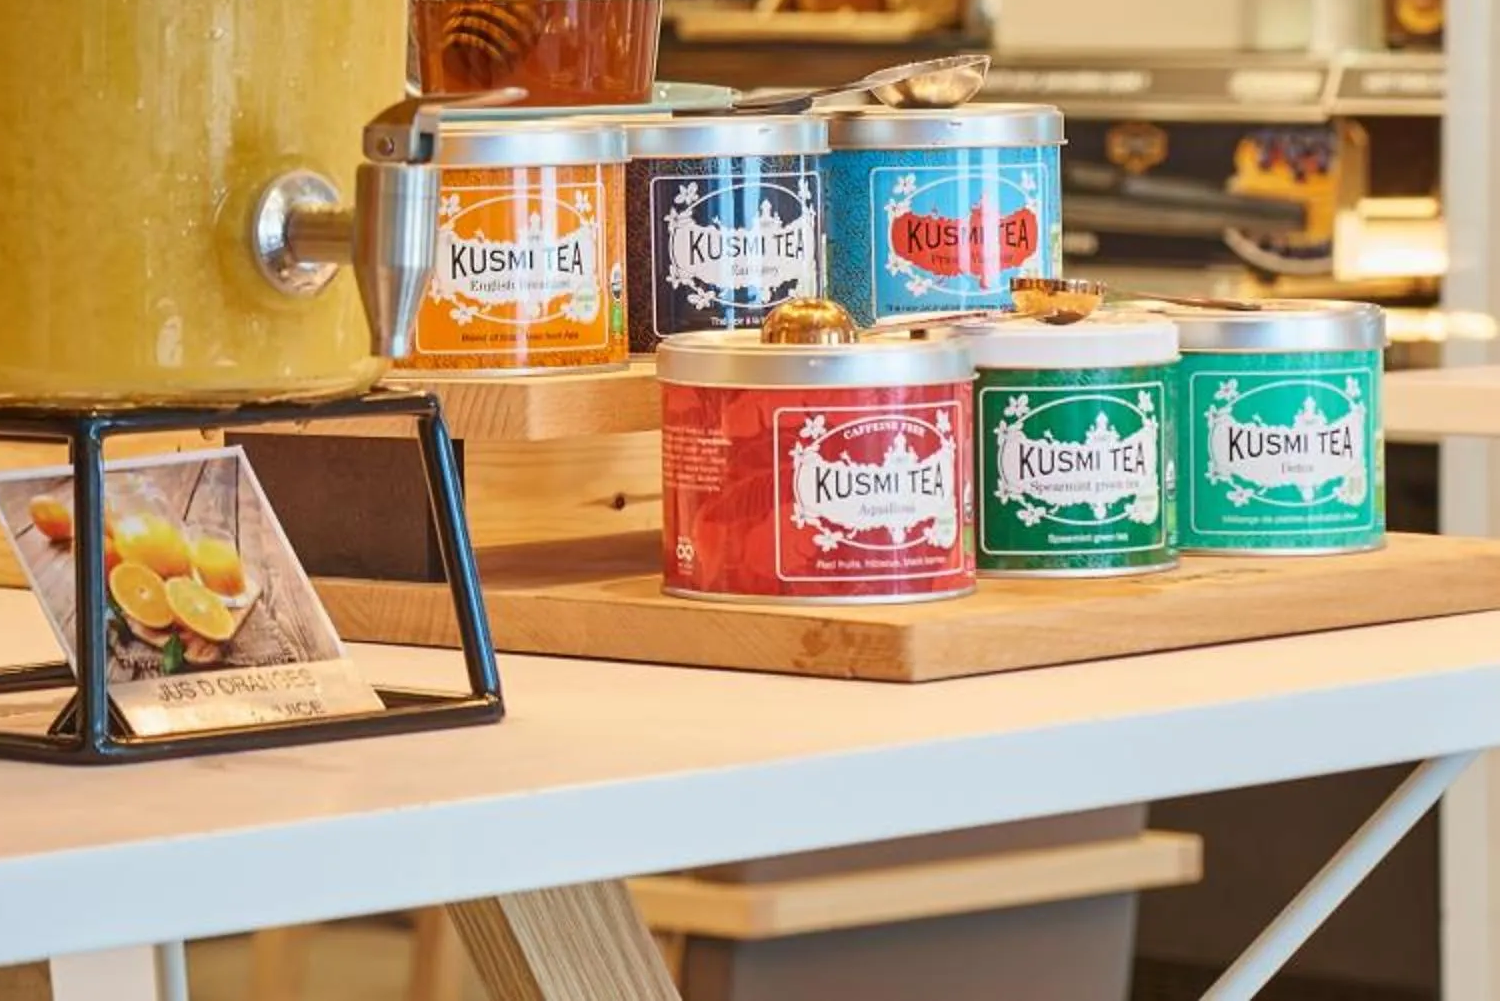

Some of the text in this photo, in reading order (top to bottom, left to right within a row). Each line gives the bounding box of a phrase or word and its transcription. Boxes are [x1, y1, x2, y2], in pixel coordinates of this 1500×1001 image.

[689, 228, 804, 266] KUSMI TEA
[907, 218, 1030, 254] KUSMI EA
[451, 241, 583, 280] KUSMI TEA
[1019, 442, 1147, 480] KUSMI TEA
[1229, 426, 1353, 462] KUSMI TEA
[816, 462, 945, 504] KUSMI TEA
[158, 679, 197, 702] JUS
